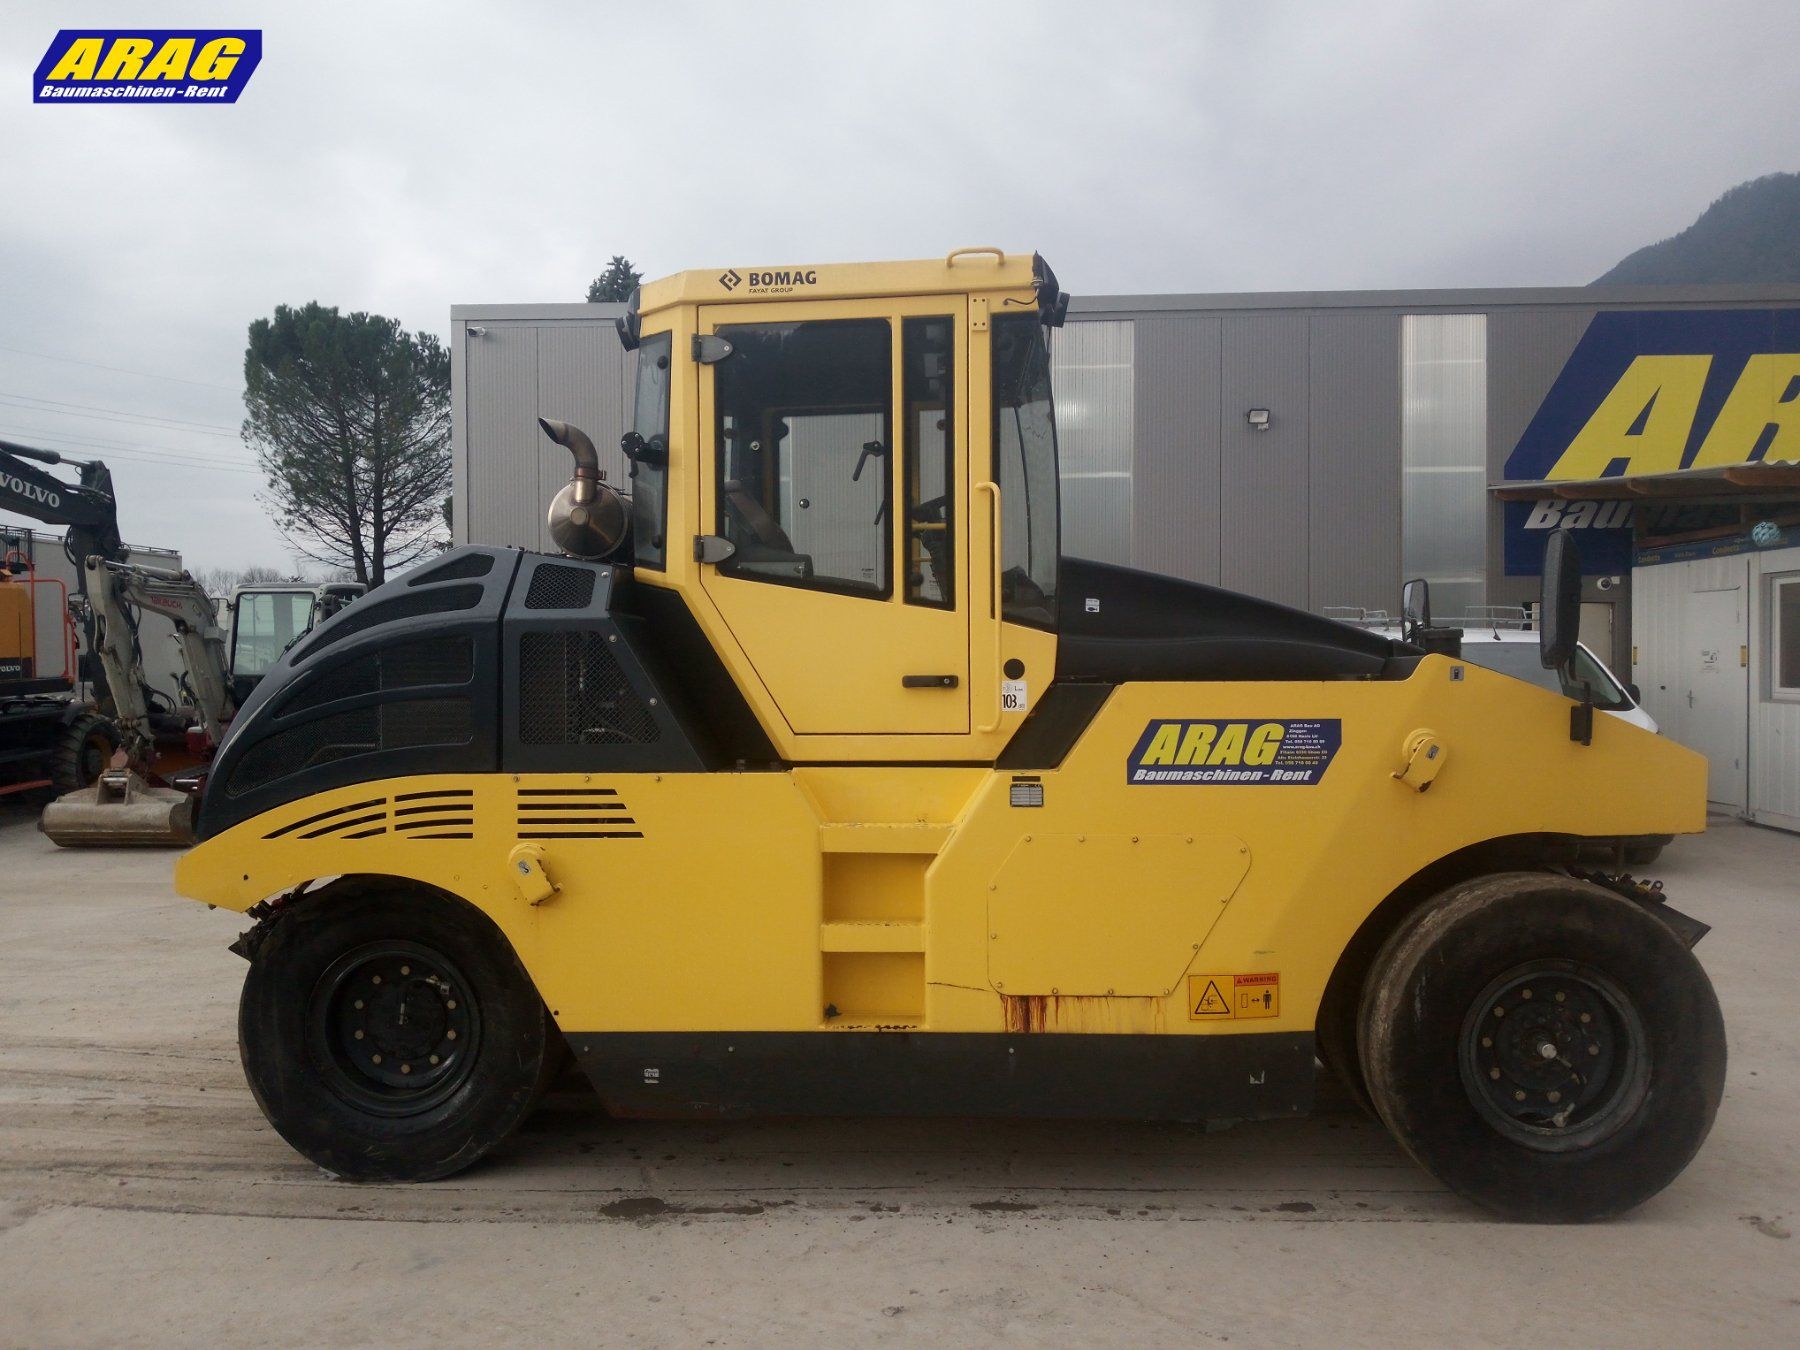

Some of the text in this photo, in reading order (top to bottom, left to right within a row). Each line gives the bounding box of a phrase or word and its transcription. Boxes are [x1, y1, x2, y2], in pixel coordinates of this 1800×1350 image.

[749, 270, 817, 287] BOMAG
[0, 471, 60, 508] VOLVO
[1002, 693, 1017, 709] 103
[1139, 722, 1285, 766] ARAG
